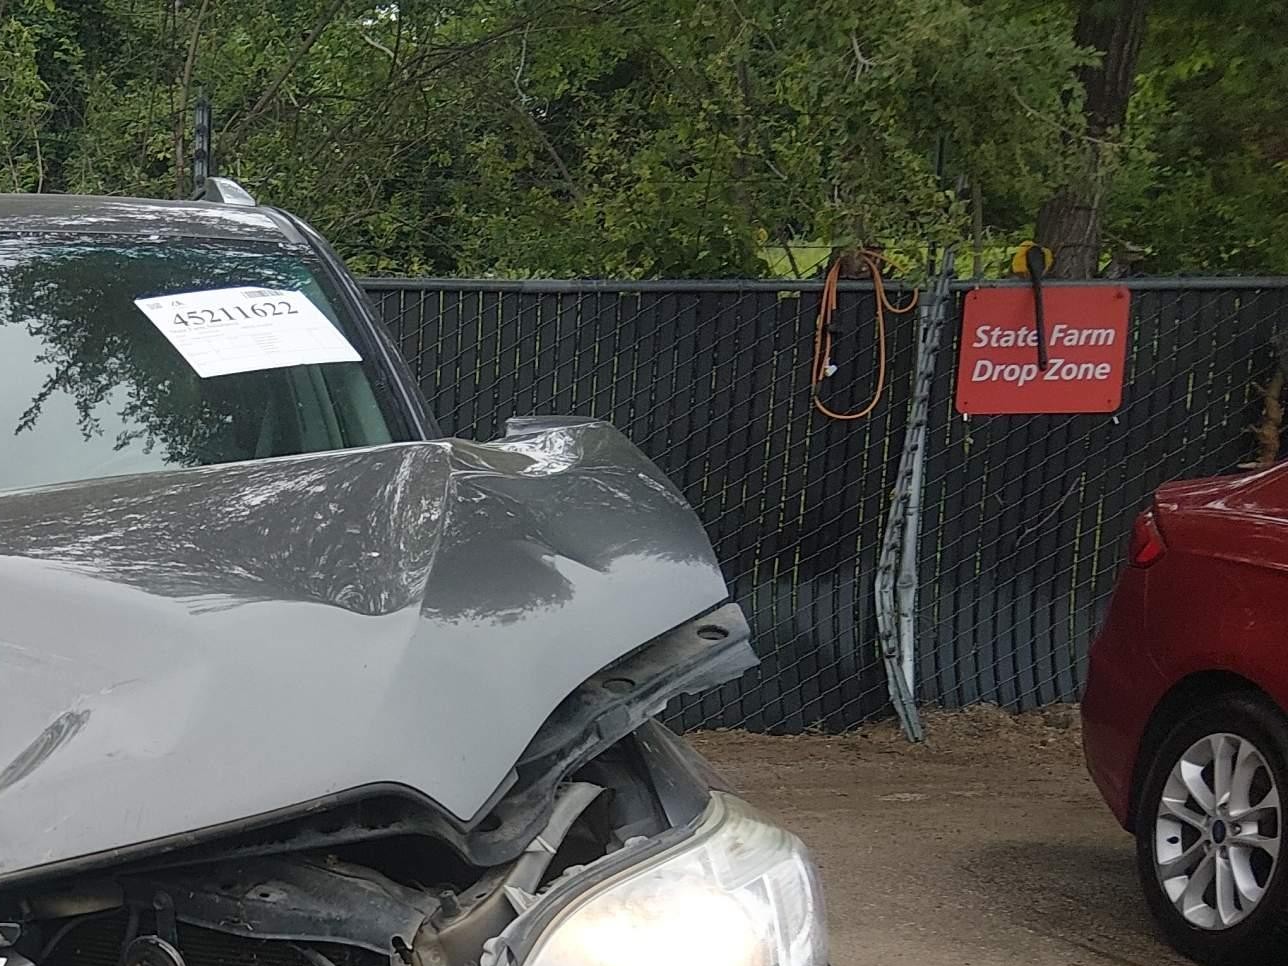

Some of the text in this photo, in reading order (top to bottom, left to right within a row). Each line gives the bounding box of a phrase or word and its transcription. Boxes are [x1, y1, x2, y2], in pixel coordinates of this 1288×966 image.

[172, 301, 299, 328] 45211622
[972, 324, 1115, 348] State Farm
[971, 358, 1111, 387] Drop Zone
